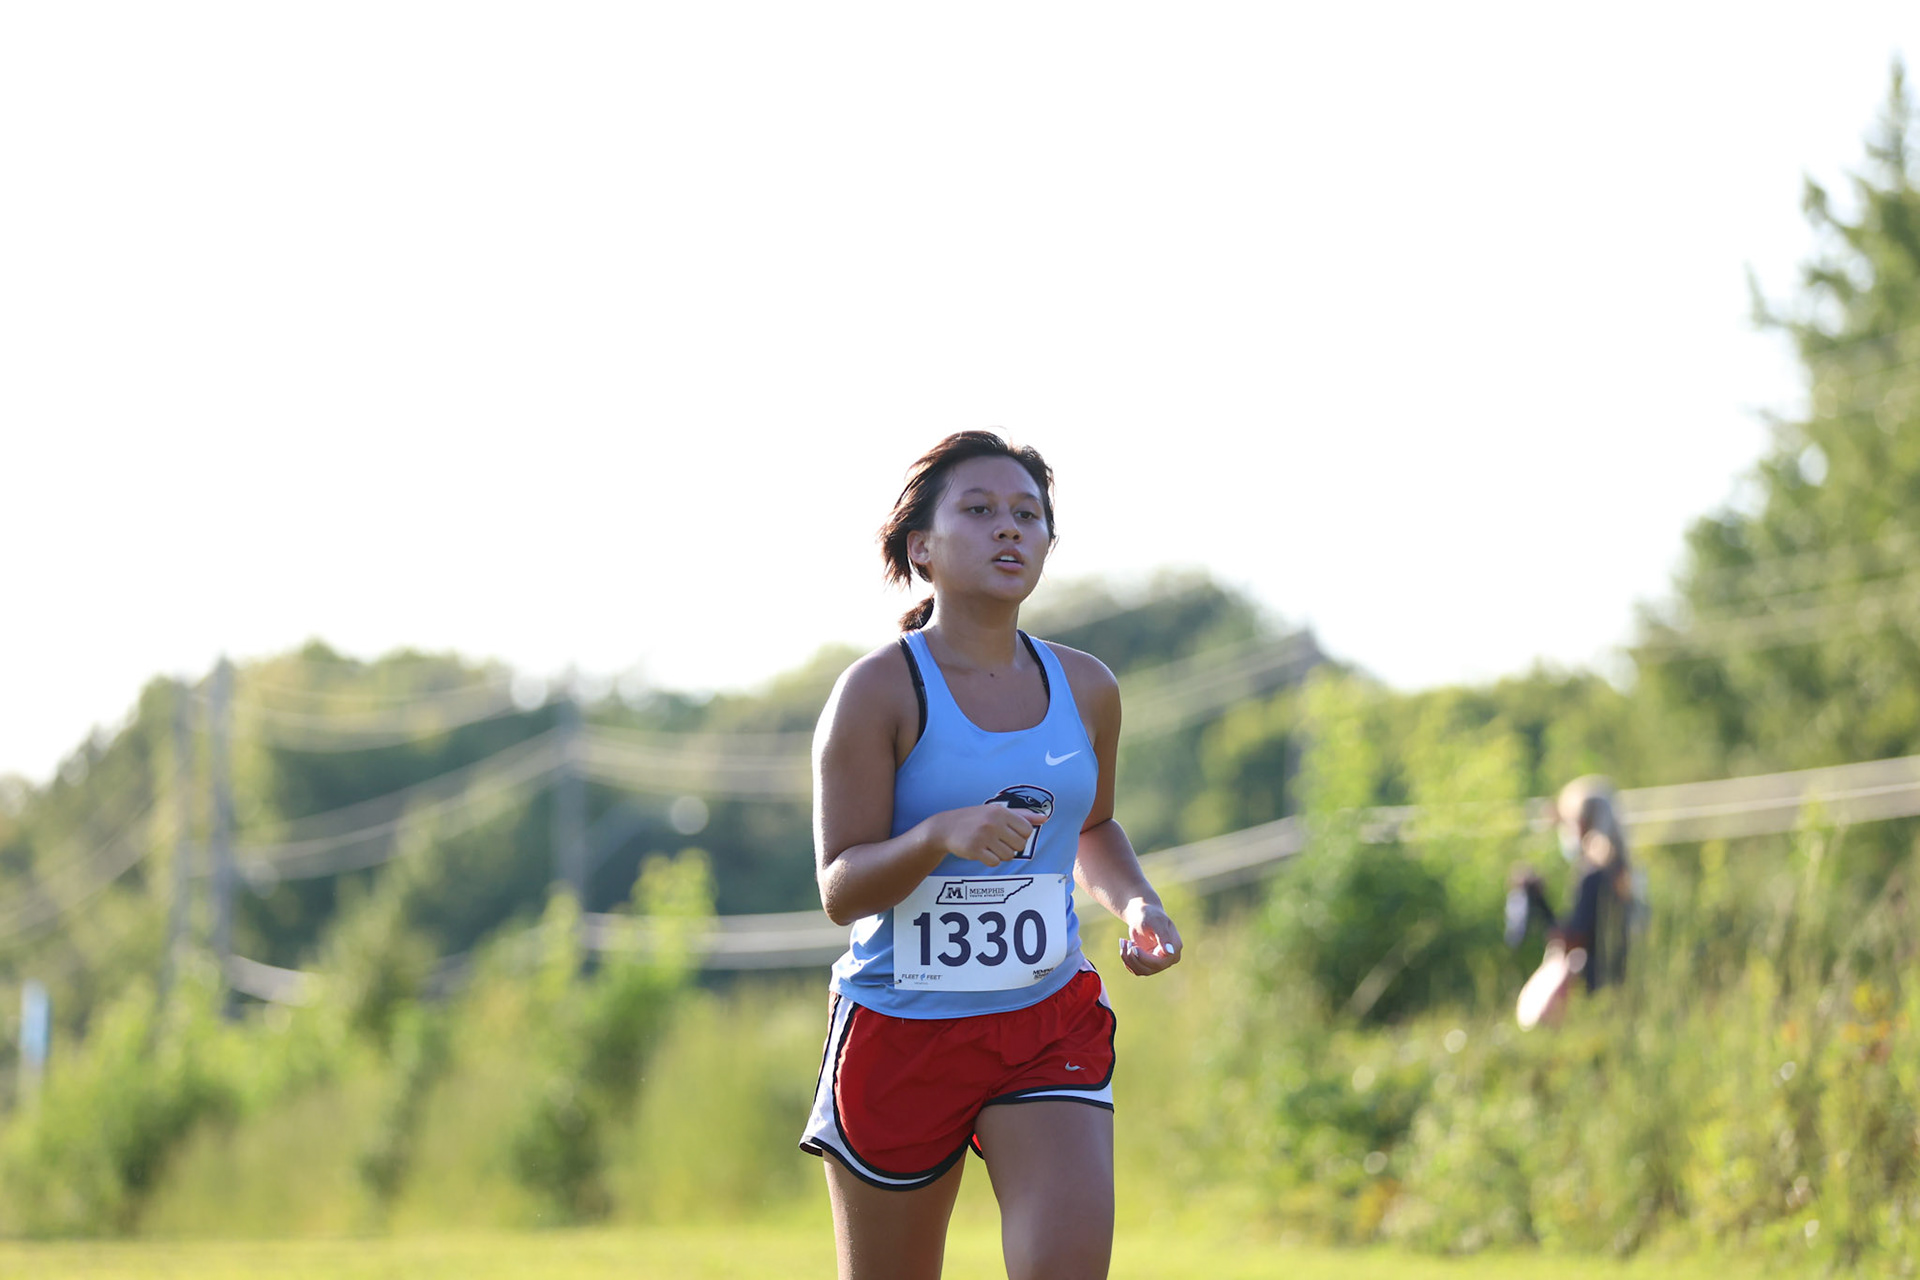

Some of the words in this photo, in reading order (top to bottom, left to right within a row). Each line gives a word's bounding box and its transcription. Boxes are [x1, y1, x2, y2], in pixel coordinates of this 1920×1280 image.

[945, 887, 964, 899] M
[969, 887, 1005, 895] MEMPHIS
[913, 909, 1047, 967] 1330
